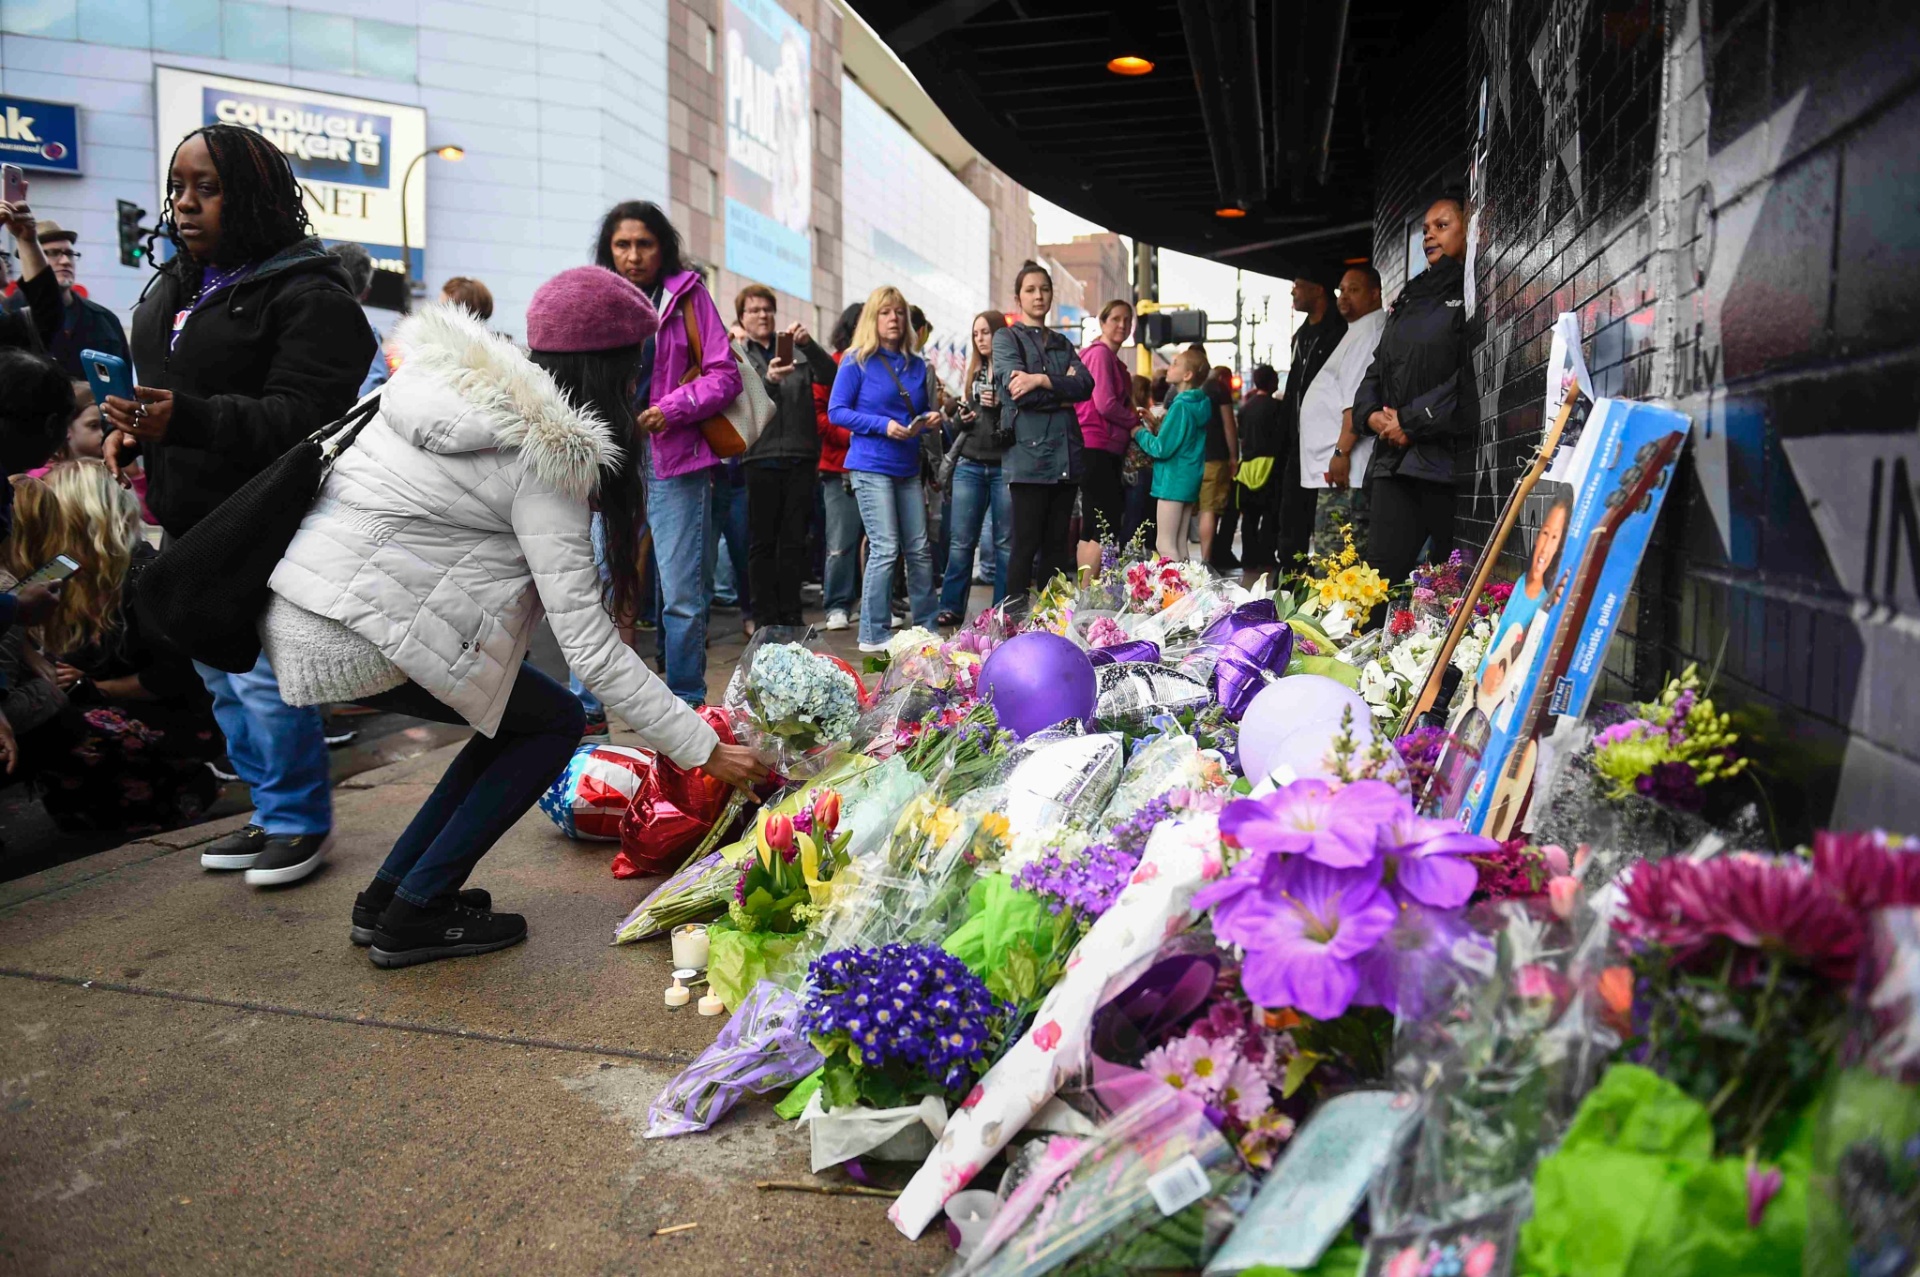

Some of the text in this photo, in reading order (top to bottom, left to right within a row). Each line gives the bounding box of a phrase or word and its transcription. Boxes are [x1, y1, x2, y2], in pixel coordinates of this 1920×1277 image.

[301, 183, 376, 219] NET
[1573, 420, 1620, 539] acoustic guitar
[1579, 592, 1617, 674] acoustic guitar
